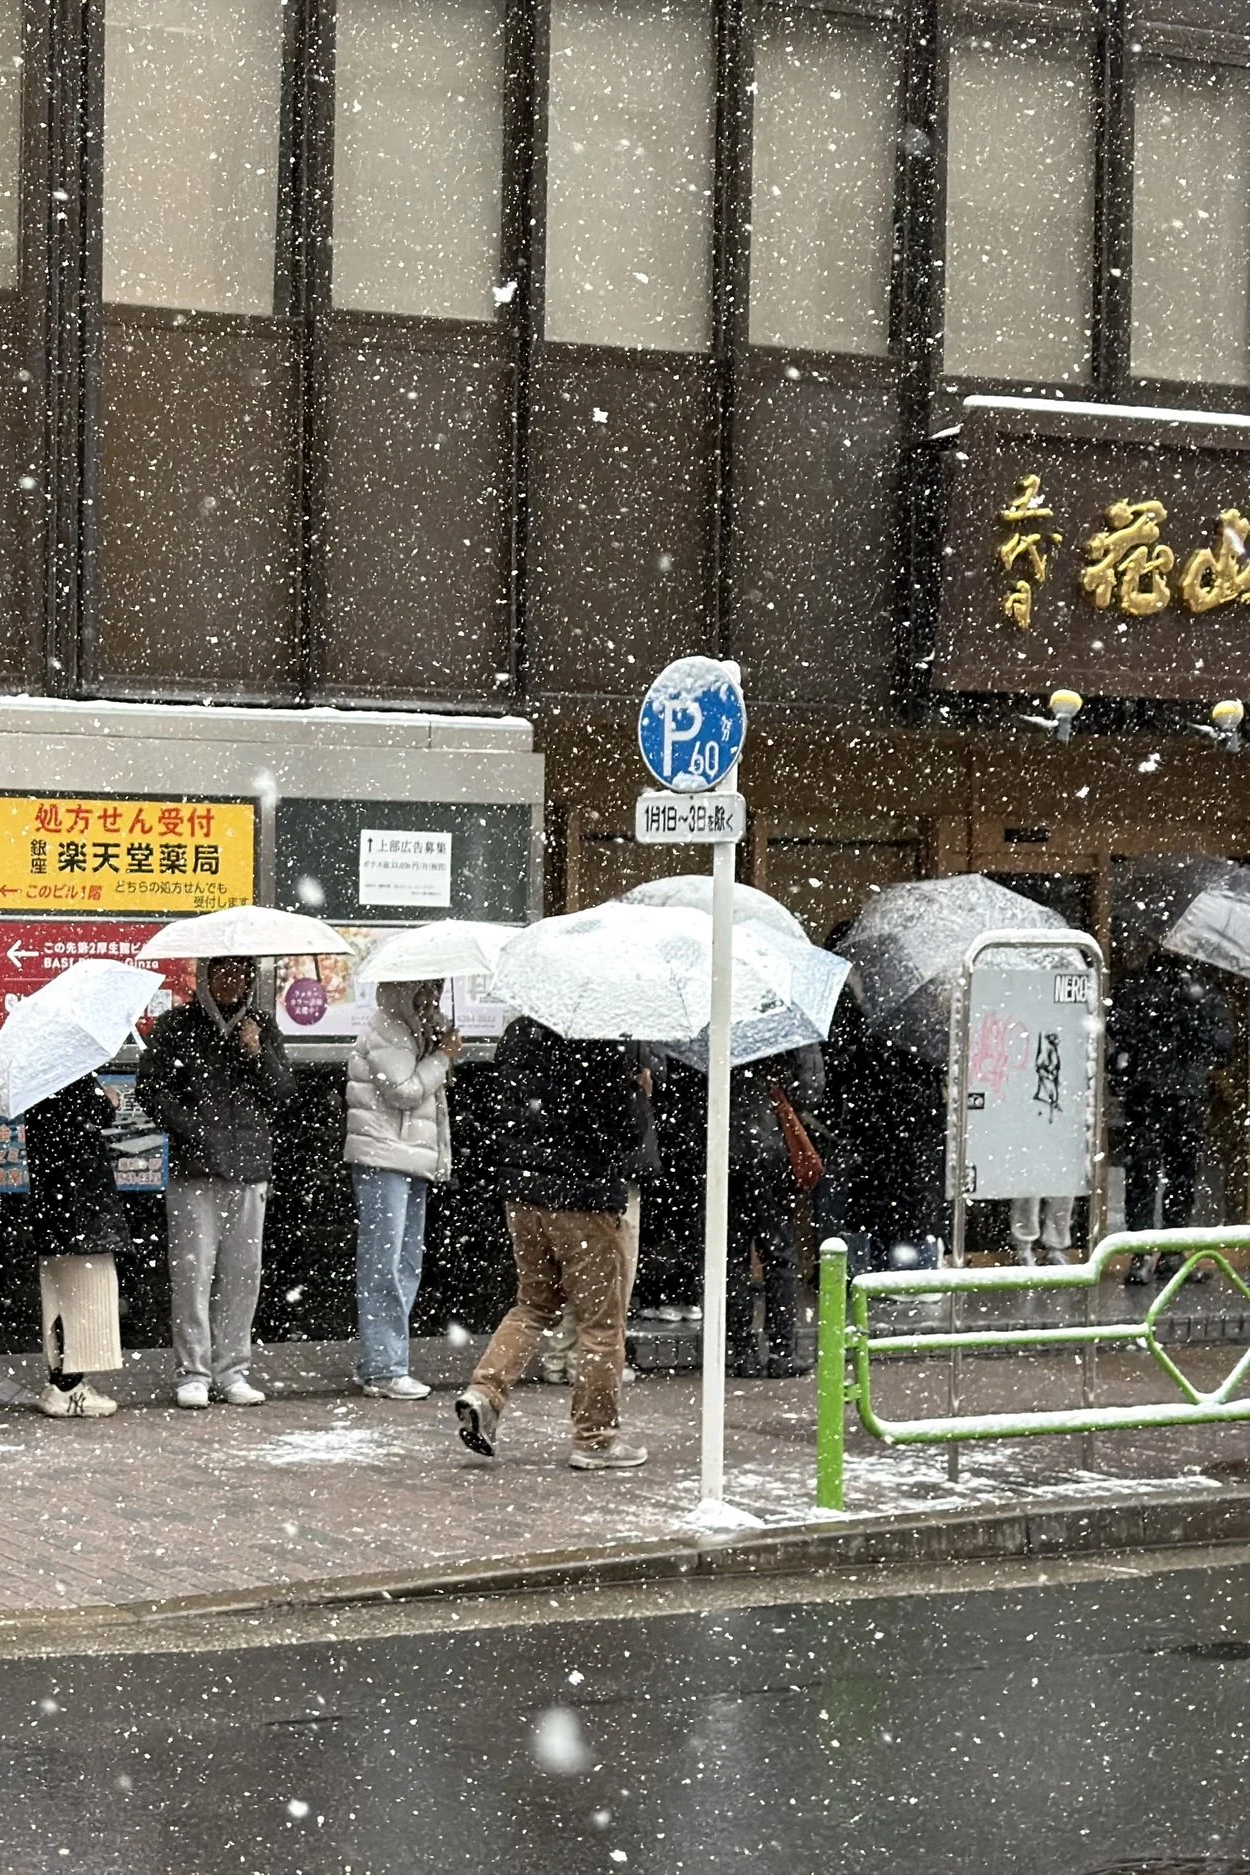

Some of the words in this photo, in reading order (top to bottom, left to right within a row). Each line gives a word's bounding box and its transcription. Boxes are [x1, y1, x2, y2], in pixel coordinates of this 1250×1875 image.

[662, 699, 703, 777] P
[35, 803, 215, 837] 処方せん受付
[377, 838, 447, 854] 上部広告募集
[30, 839, 48, 874] 銀座
[58, 842, 220, 875] 楽天堂薬局
[25, 884, 103, 900] このビル1階
[115, 881, 228, 895] どちらの処方せんでも
[193, 896, 250, 909] 受付します
[43, 942, 148, 955] この先第2厚生館ビ
